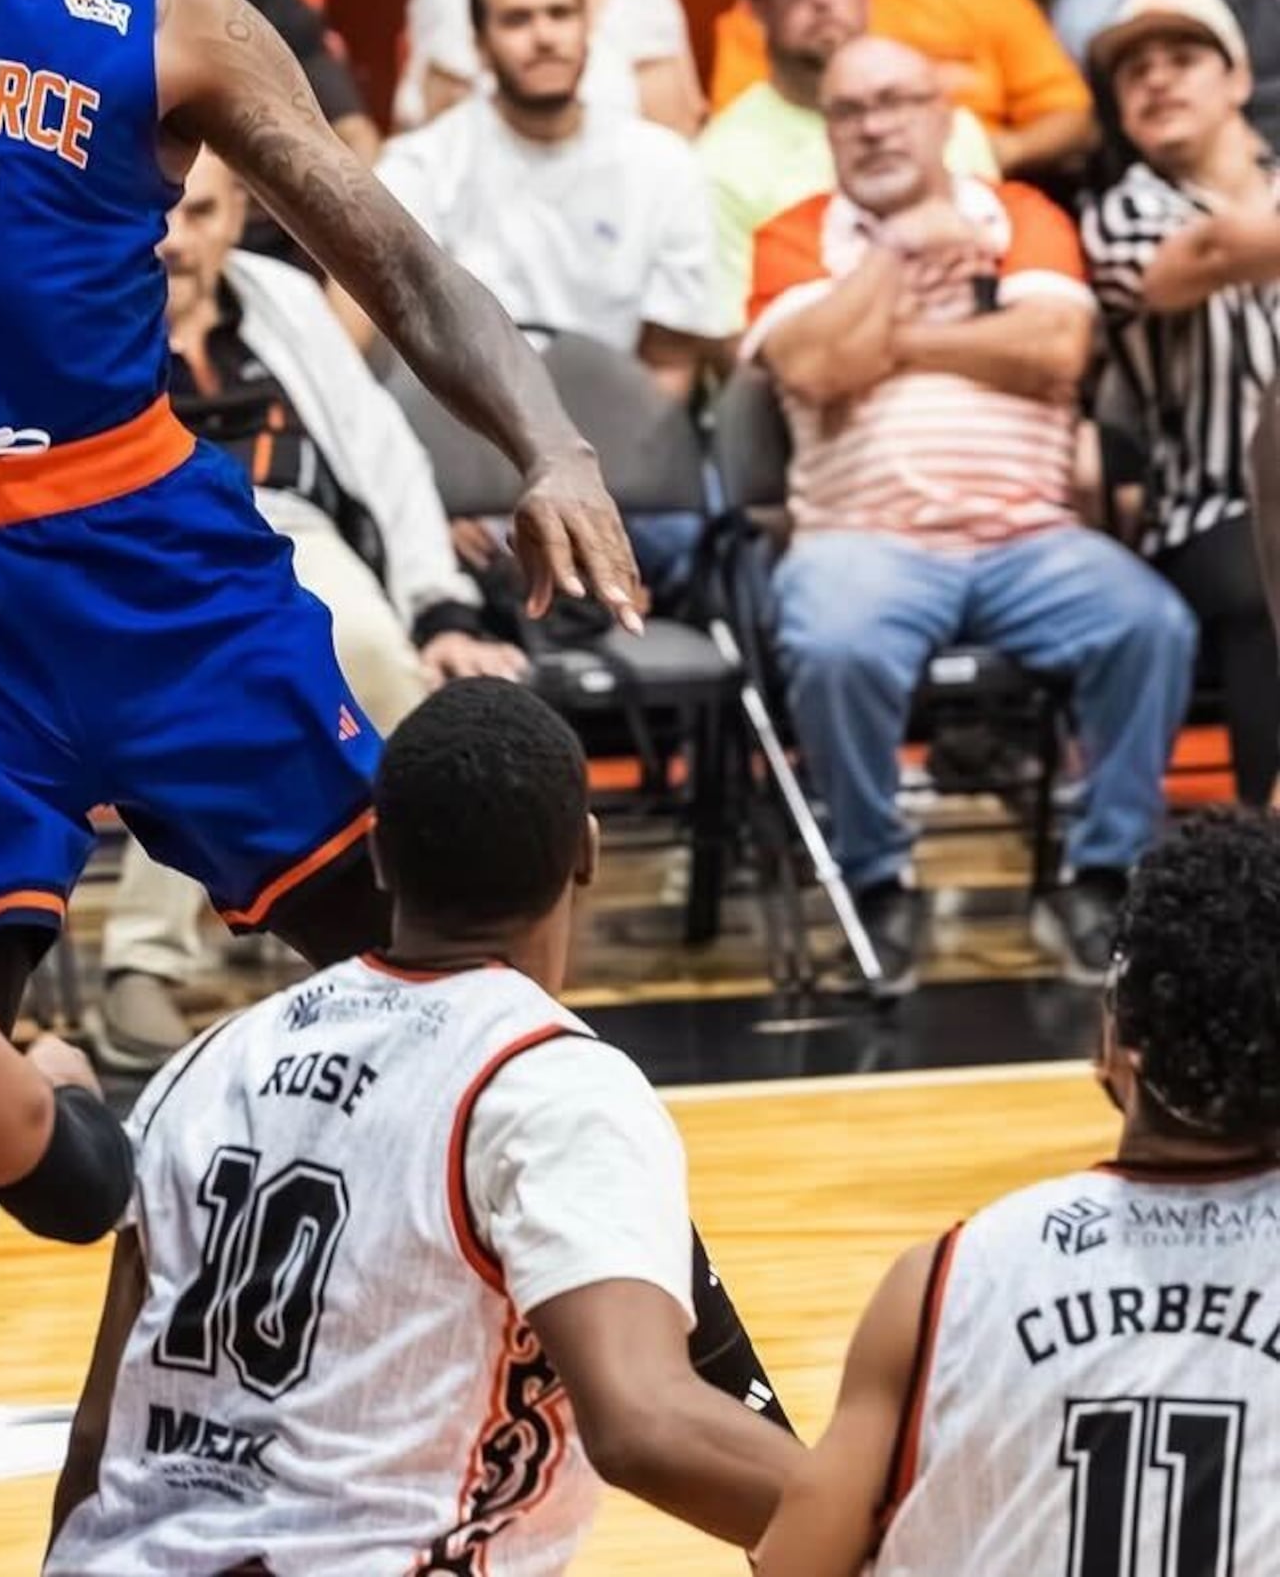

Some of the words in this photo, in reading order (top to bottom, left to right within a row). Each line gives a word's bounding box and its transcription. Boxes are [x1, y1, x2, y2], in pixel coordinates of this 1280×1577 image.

[259, 1052, 380, 1117] ROSE
[153, 1145, 351, 1402] 10
[1057, 1395, 1247, 1577] 11
